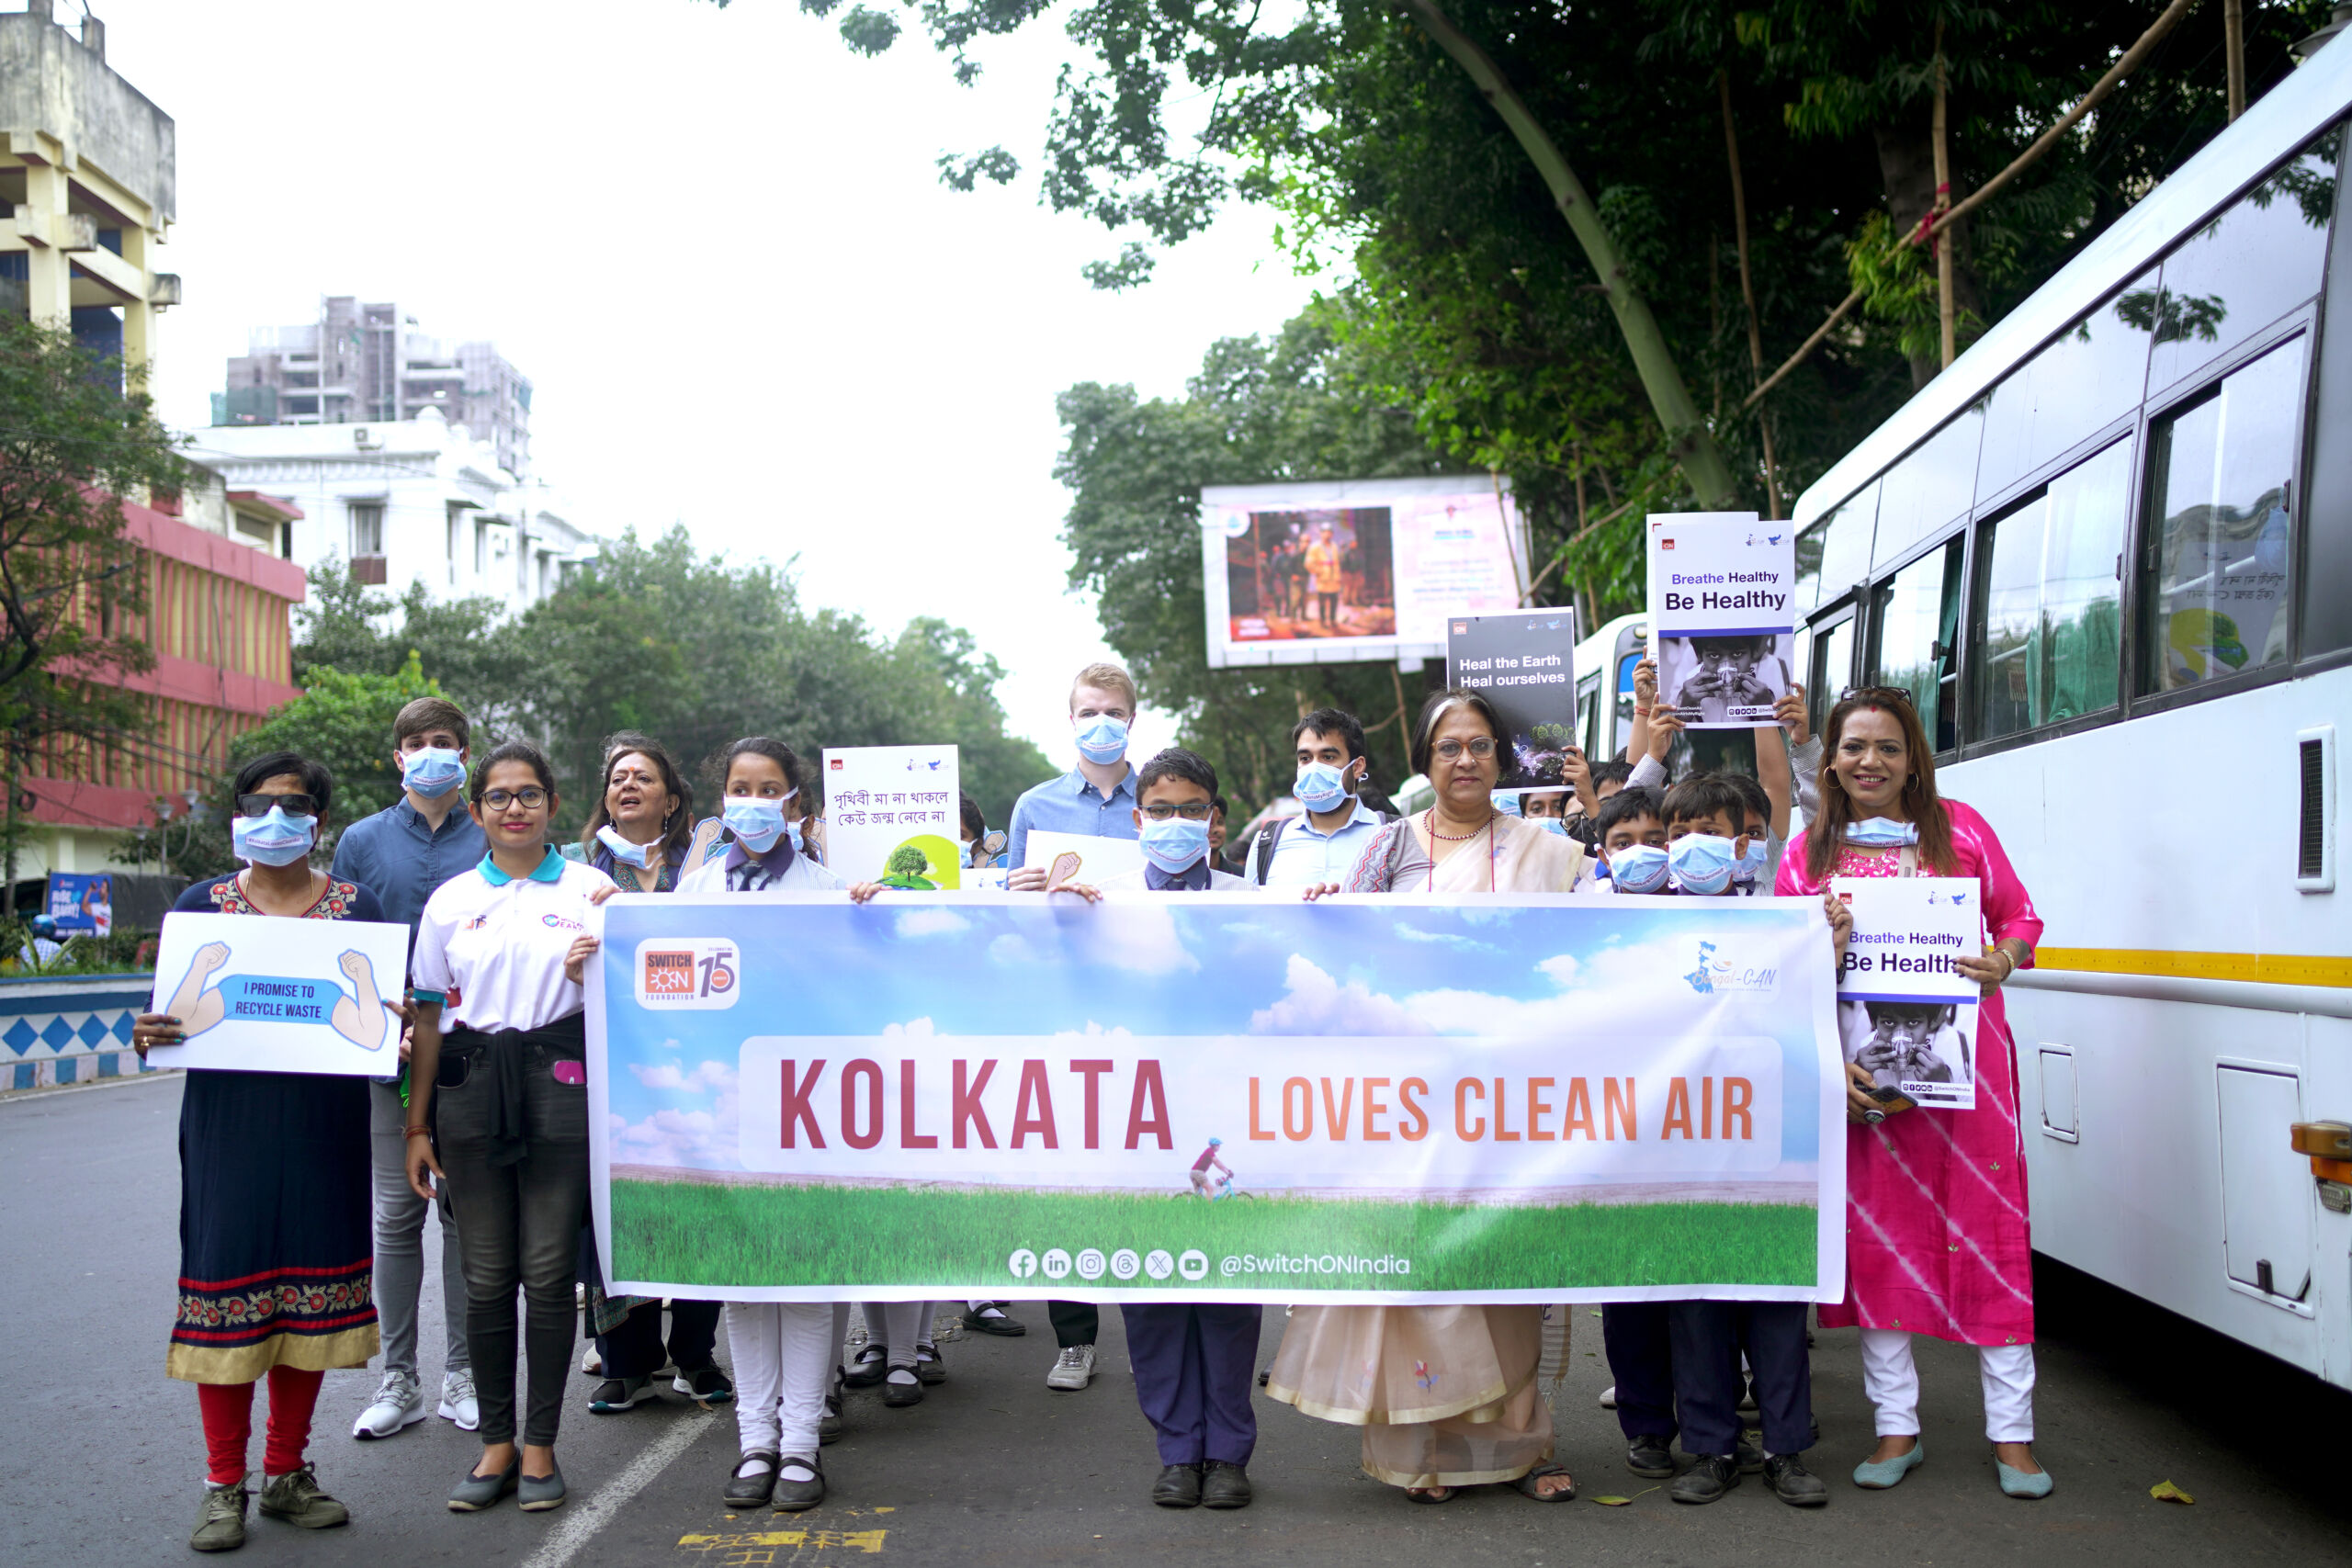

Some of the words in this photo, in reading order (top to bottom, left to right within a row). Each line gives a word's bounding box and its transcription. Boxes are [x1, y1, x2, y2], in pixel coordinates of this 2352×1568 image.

[1672, 573, 1724, 585] Breathe
[1728, 571, 1780, 584] Healthy
[1666, 592, 1694, 611] Be
[1702, 590, 1786, 611] Healthy
[1460, 658, 1491, 671] Heal
[1496, 657, 1519, 669] the
[1523, 655, 1561, 668] Earth
[1461, 675, 1492, 689] Heal
[1497, 672, 1566, 686] ourselves
[834, 790, 870, 810] পৃথিবী
[874, 794, 888, 806] মা
[892, 793, 906, 805] না
[910, 791, 949, 805] থাকলে
[838, 810, 866, 826] কেউ
[871, 812, 895, 825] জন্ম
[899, 811, 927, 824] নেবে
[931, 811, 945, 823] না
[1849, 931, 1905, 944] Breathe
[1909, 932, 1963, 947] Healthy
[648, 954, 692, 967] SWITCH
[1844, 953, 1872, 971] Be
[698, 953, 735, 998] 15
[243, 982, 249, 995] I
[251, 983, 299, 998] PROMISE
[301, 986, 315, 998] TO
[236, 1001, 283, 1016] RECYCLE
[286, 1004, 322, 1019] WASTE
[780, 1059, 1174, 1150] KOLKATA
[1249, 1077, 1430, 1142] LOVES
[1454, 1077, 1638, 1142] CLEAN
[1661, 1076, 1754, 1141] AIR
[1219, 1253, 1411, 1278] @SwitchONIndia
